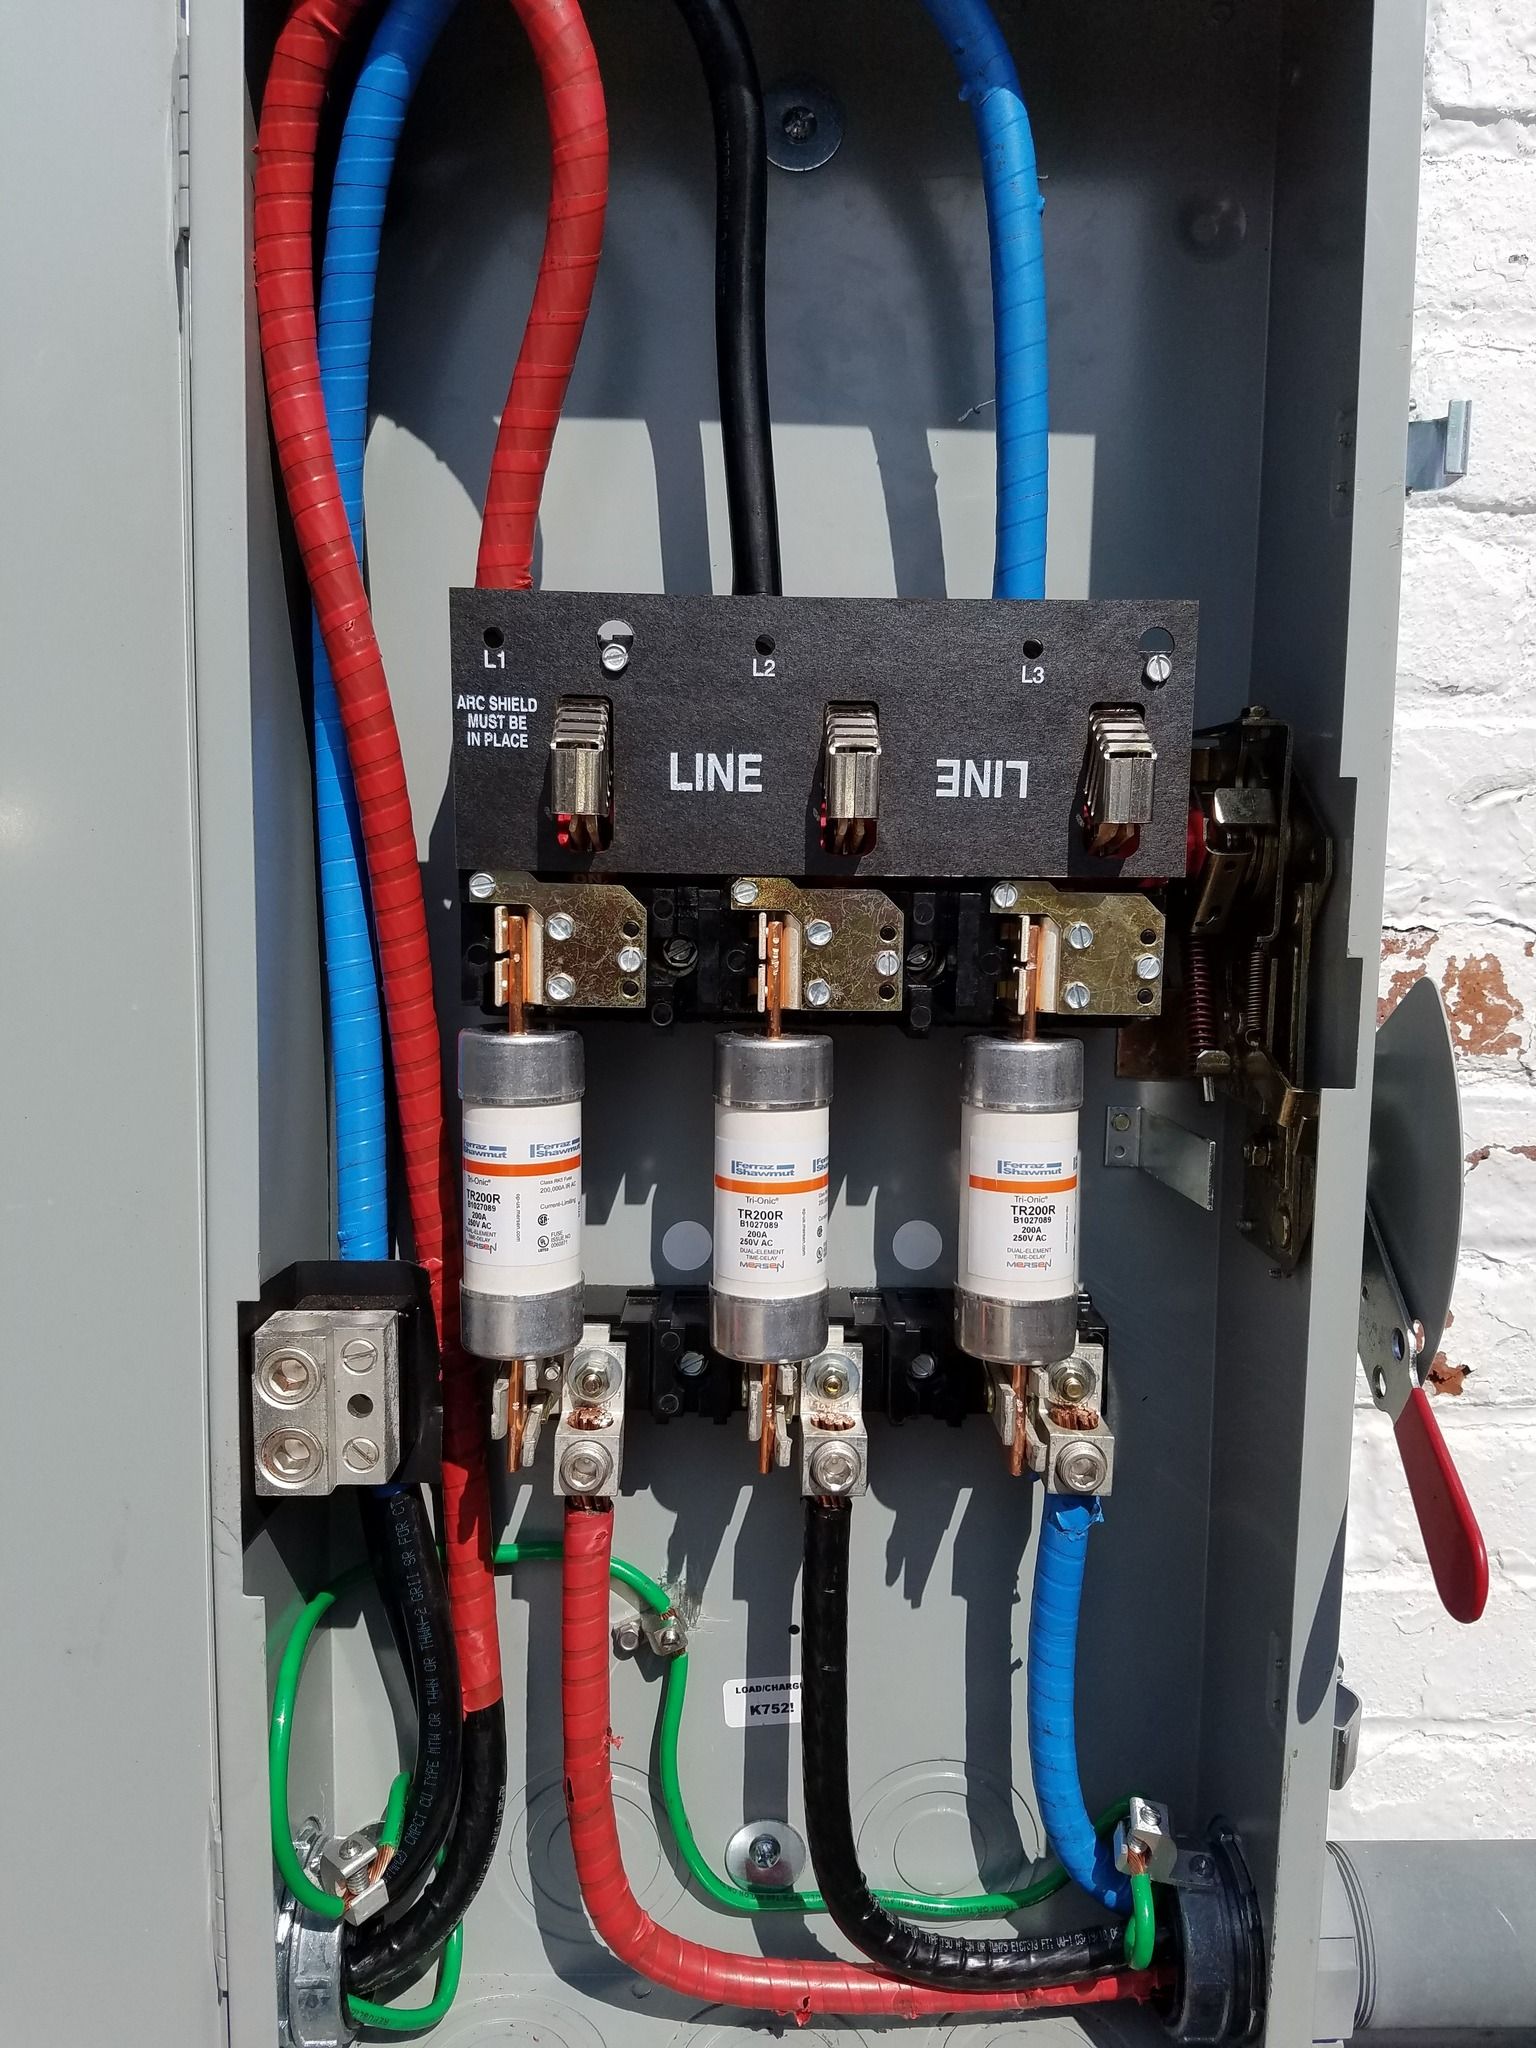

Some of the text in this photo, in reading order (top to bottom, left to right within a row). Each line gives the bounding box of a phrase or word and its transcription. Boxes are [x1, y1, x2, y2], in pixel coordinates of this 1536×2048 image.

[484, 650, 505, 669] L1
[752, 658, 776, 677] L2
[1021, 665, 1045, 684] L3
[457, 695, 538, 713] ARC SHIELD
[468, 713, 527, 730] MUST BE
[467, 732, 529, 748] IN PLACE
[670, 751, 763, 793] LINE
[936, 759, 1029, 799] LINE
[536, 1140, 571, 1151] Ferraz
[736, 1161, 776, 1171] Ferraz
[1003, 1161, 1045, 1169] Ferraz
[736, 1168, 795, 1177] Shawmut
[1003, 1167, 1062, 1176] Shawmut
[466, 1188, 501, 1204] TR200R
[467, 1200, 497, 1212] B1027089
[1010, 1205, 1056, 1216] TR200R
[472, 1211, 487, 1221] 200A
[738, 1208, 783, 1221] TR200R
[482, 1222, 492, 1230] AC
[740, 1220, 779, 1229] B1027089
[1021, 1226, 1042, 1234] 200A
[747, 1230, 768, 1239] 200A
[1013, 1234, 1047, 1242] 250V AC
[740, 1238, 773, 1247] 250V AC
[395, 1519, 414, 1545] FOR
[423, 1656, 437, 1672] OR
[428, 1712, 441, 1727] OR
